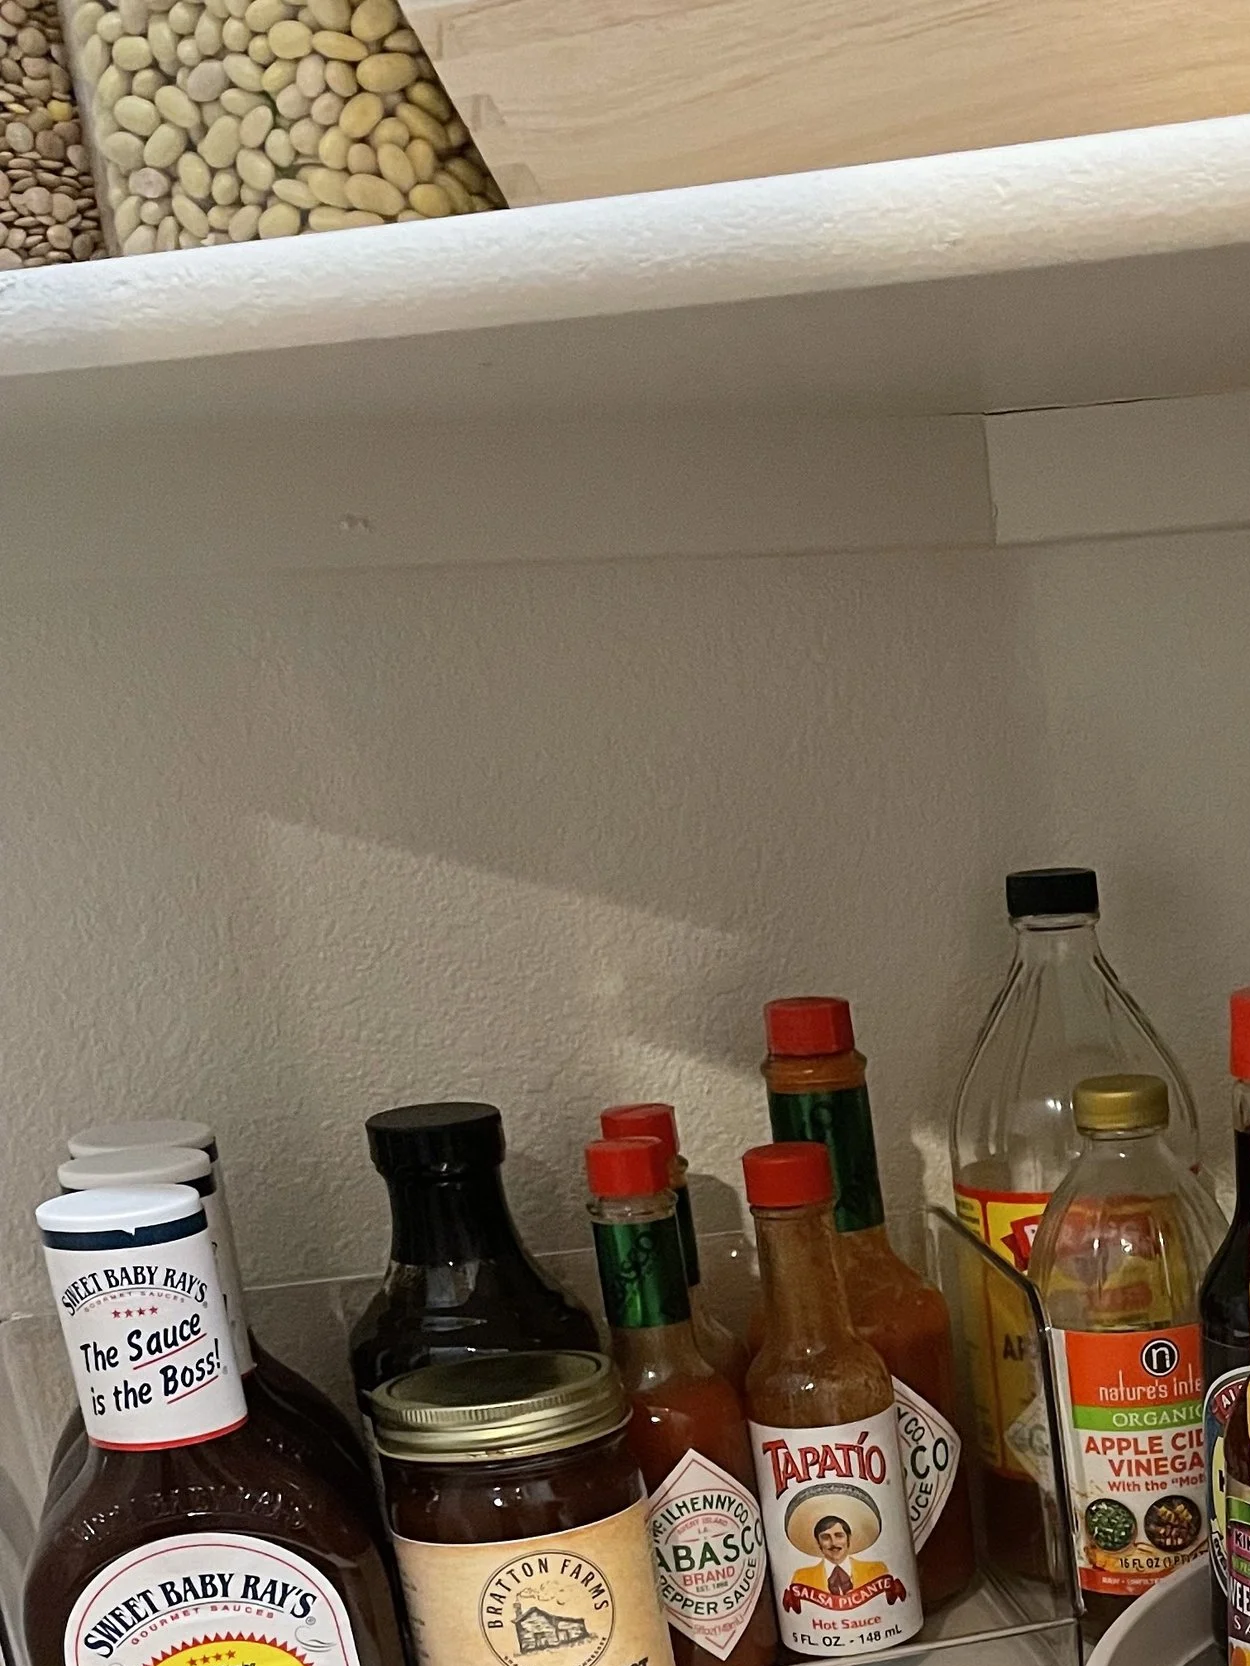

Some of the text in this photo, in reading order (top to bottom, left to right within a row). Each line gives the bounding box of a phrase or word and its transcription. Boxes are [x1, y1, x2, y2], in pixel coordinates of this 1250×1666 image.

[61, 1266, 208, 1316] SWEET BABY RAY'S
[80, 1313, 201, 1373] The Sauce
[90, 1338, 221, 1416] is the Boss!
[1099, 1369, 1168, 1402] nature's
[762, 1431, 887, 1500] TAPATÍO
[1085, 1435, 1163, 1456] APPLE
[1108, 1479, 1168, 1493] With the
[486, 1557, 609, 1629] BRATTON FARMS
[682, 1565, 736, 1587] BRAND
[722, 1558, 757, 1610] SAUCE
[792, 1578, 892, 1608] SALSA PICANTE
[84, 1573, 317, 1659] SWEET BABY RAY'S
[131, 1604, 275, 1645] GOURMET SAUCES
[792, 1624, 902, 1644] 5 148 mL
[812, 1616, 881, 1630] Hot Sauce
